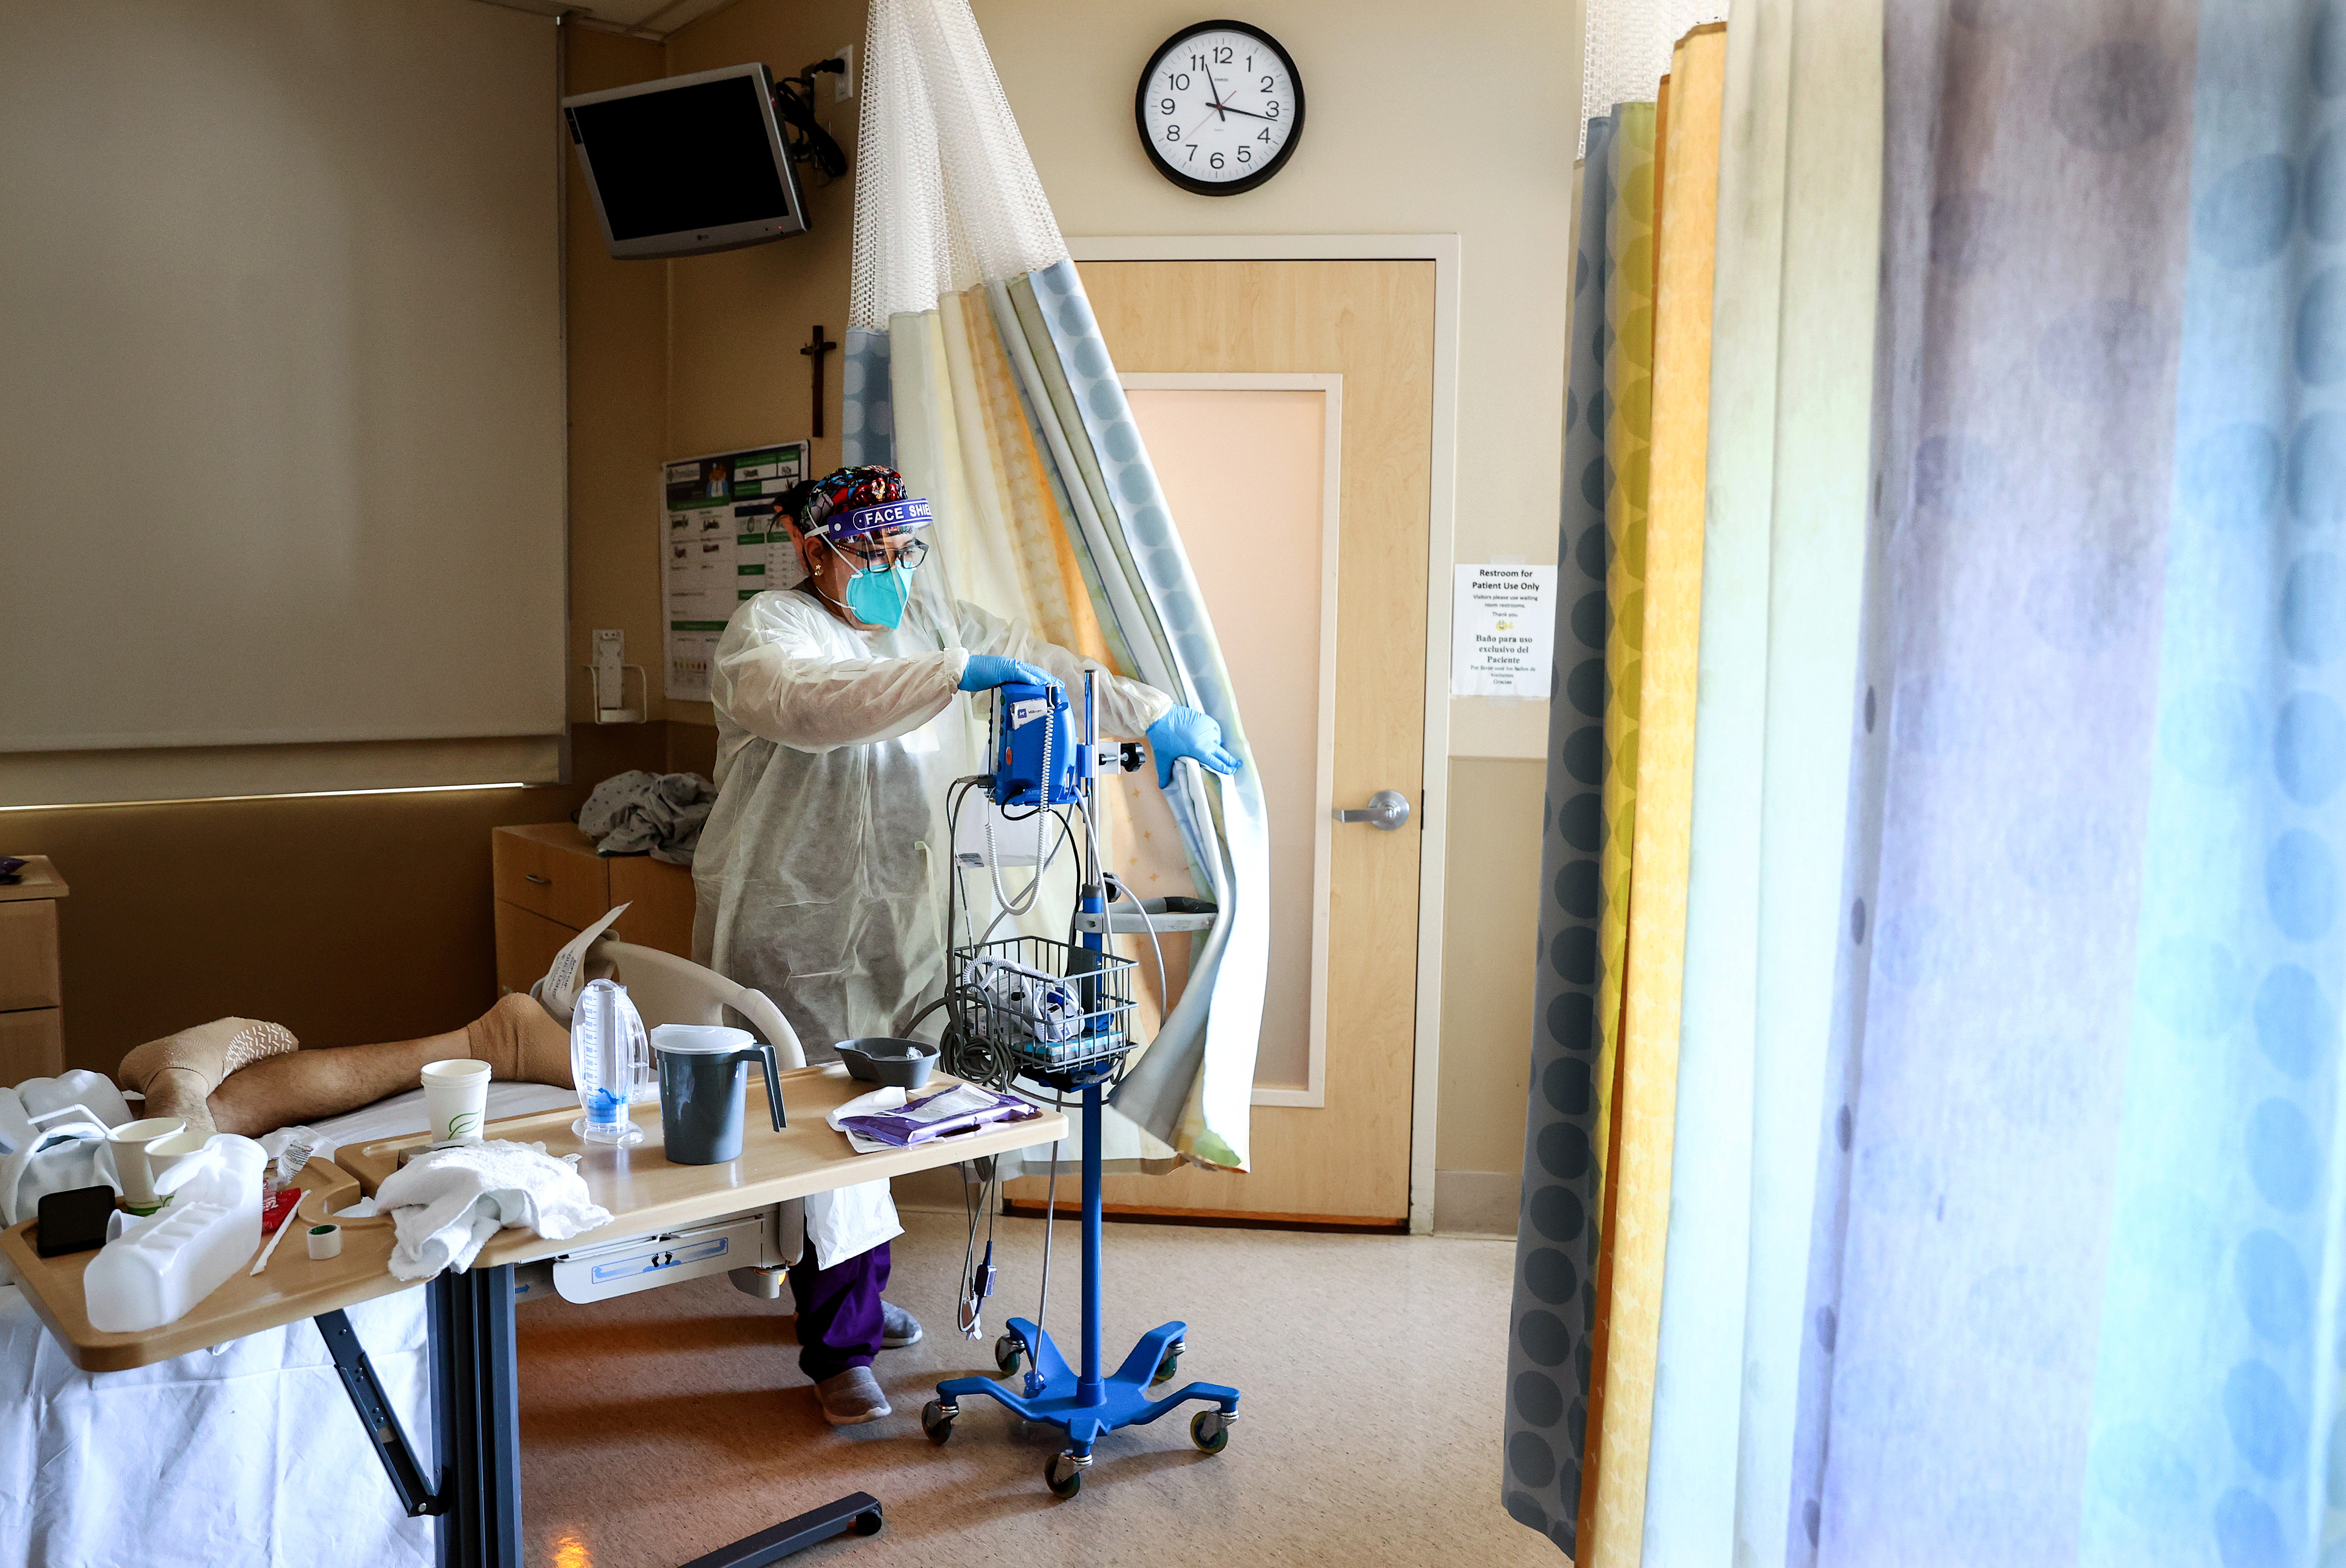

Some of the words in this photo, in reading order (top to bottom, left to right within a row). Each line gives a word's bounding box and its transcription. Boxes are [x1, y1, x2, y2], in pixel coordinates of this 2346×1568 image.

[1191, 55, 1205, 71] 11
[1213, 47, 1233, 64] 12
[1246, 55, 1252, 72] 1
[1168, 74, 1190, 91] 10
[1260, 76, 1273, 93] 2
[1161, 98, 1175, 115] 9
[1265, 101, 1279, 118] 3
[1166, 125, 1180, 141] 8
[1257, 127, 1271, 143] 4
[1186, 145, 1197, 161] 7
[1210, 152, 1224, 169] 6
[1237, 146, 1251, 163] 5
[865, 506, 904, 525] FACE
[1521, 582, 1540, 592] Only
[1487, 656, 1520, 664] Paciente
